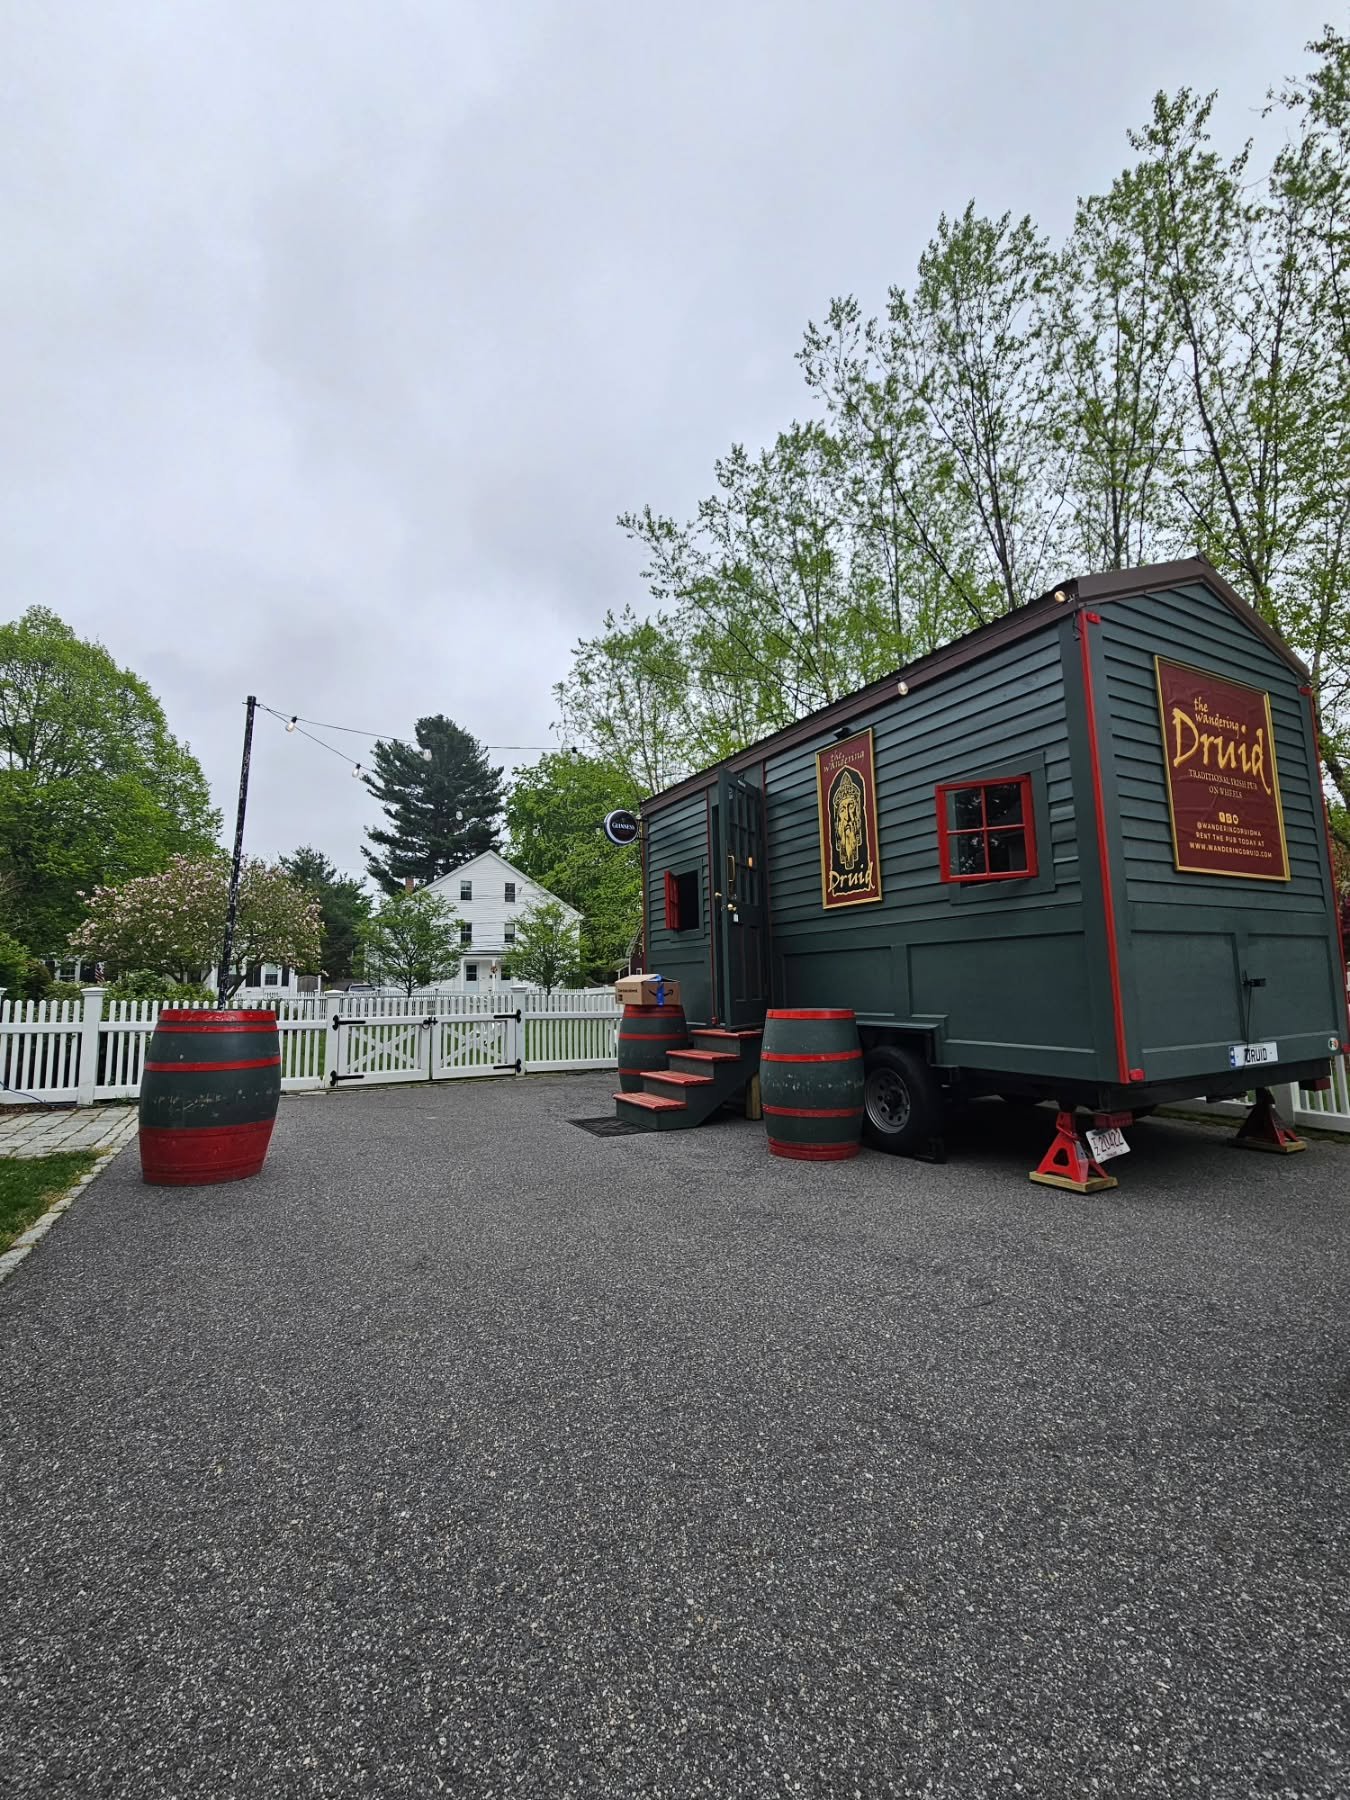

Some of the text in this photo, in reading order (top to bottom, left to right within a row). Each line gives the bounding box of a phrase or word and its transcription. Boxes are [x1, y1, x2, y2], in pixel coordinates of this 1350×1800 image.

[1193, 696, 1208, 712] the
[1195, 712, 1240, 739] wandering
[1172, 707, 1271, 795] Druid
[1188, 768, 1230, 785] TRADITIONAL
[1230, 777, 1247, 789] IRISH
[1208, 785, 1242, 799] ON WHEELS
[612, 822, 635, 830] GUINNESS
[1195, 831, 1265, 848] RENT THE PUB TODAY AT
[1188, 841, 1273, 858] WWW.WANDERINGDRUID.COM
[828, 861, 876, 893] Druid
